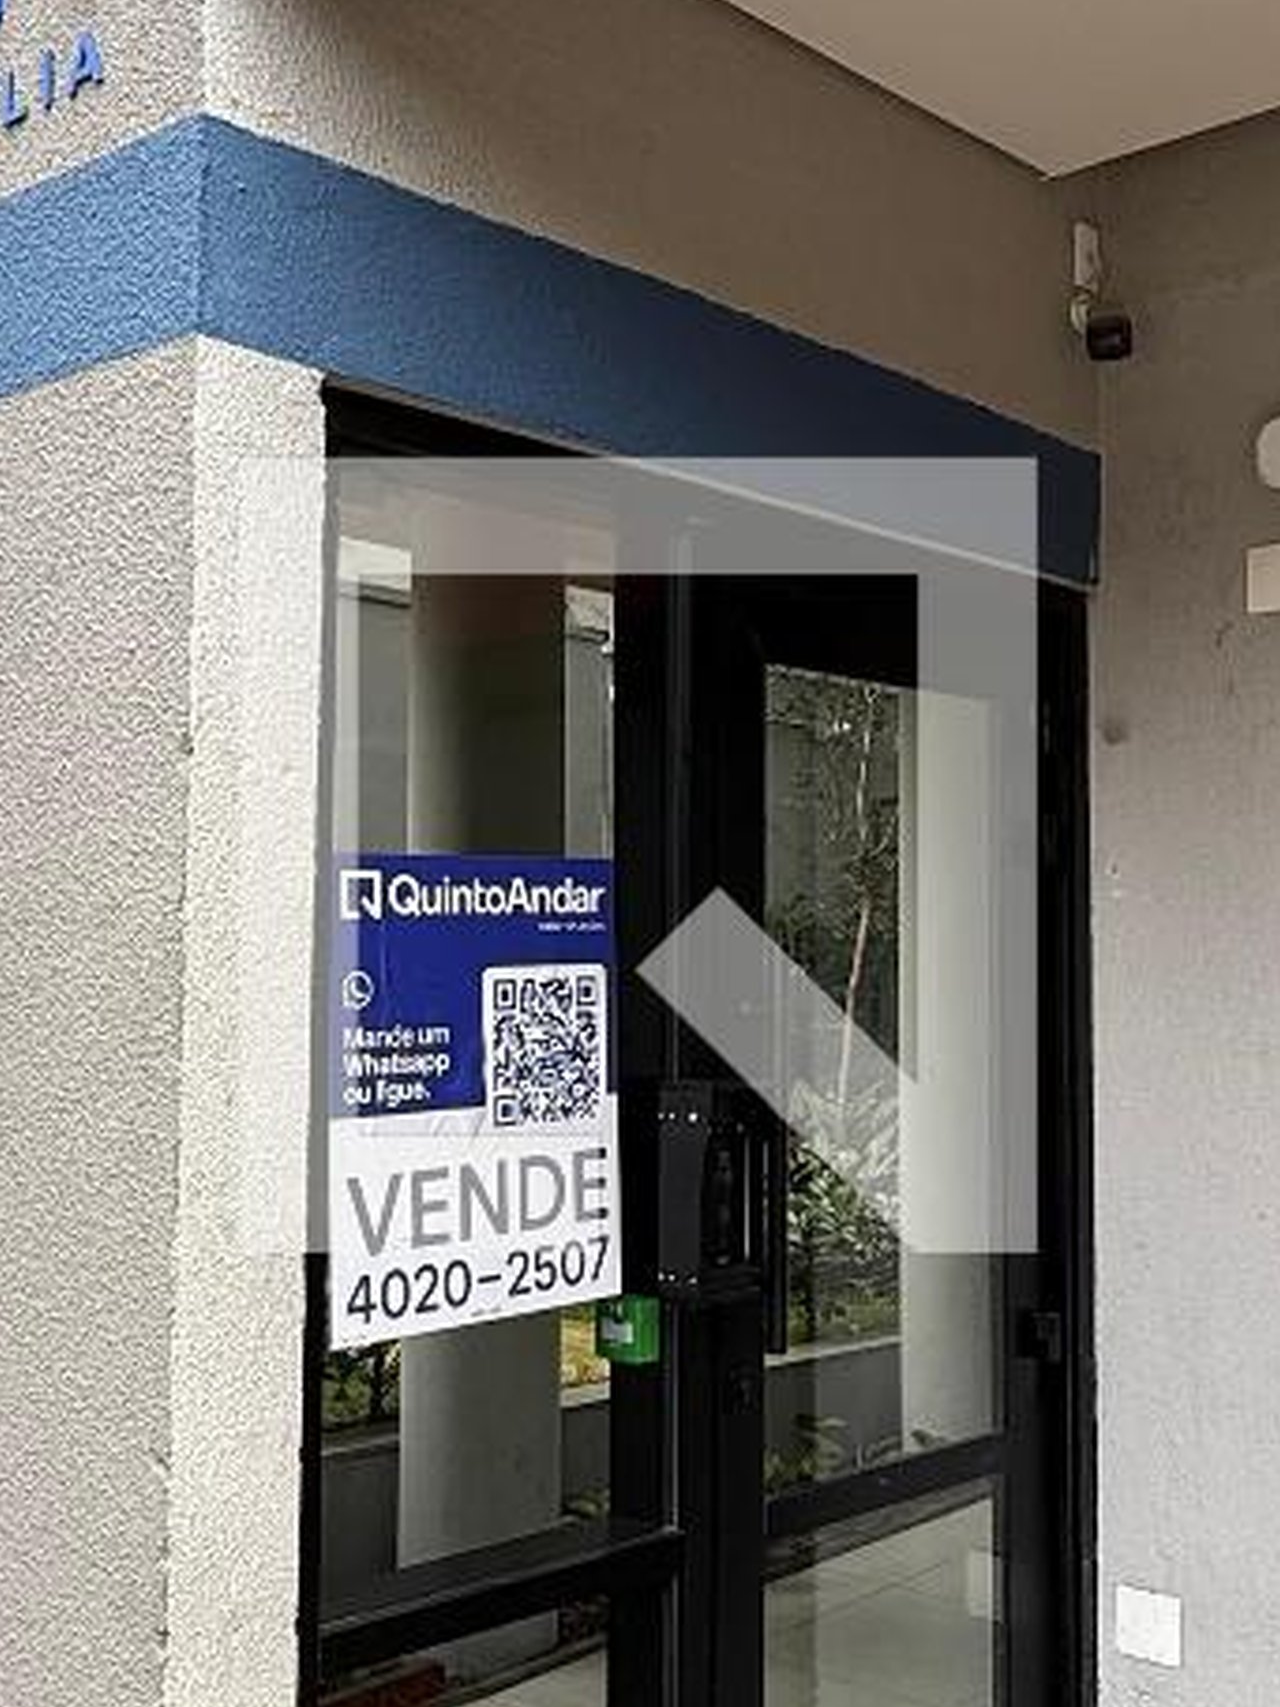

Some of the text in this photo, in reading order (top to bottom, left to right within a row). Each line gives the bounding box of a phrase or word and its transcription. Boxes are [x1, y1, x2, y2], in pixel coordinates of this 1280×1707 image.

[388, 873, 607, 917] QuintoAndar
[341, 1024, 451, 1050] Mande um
[341, 1085, 372, 1107] ou
[346, 1147, 609, 1257] VENDE
[346, 1234, 610, 1325] 4020-2507
